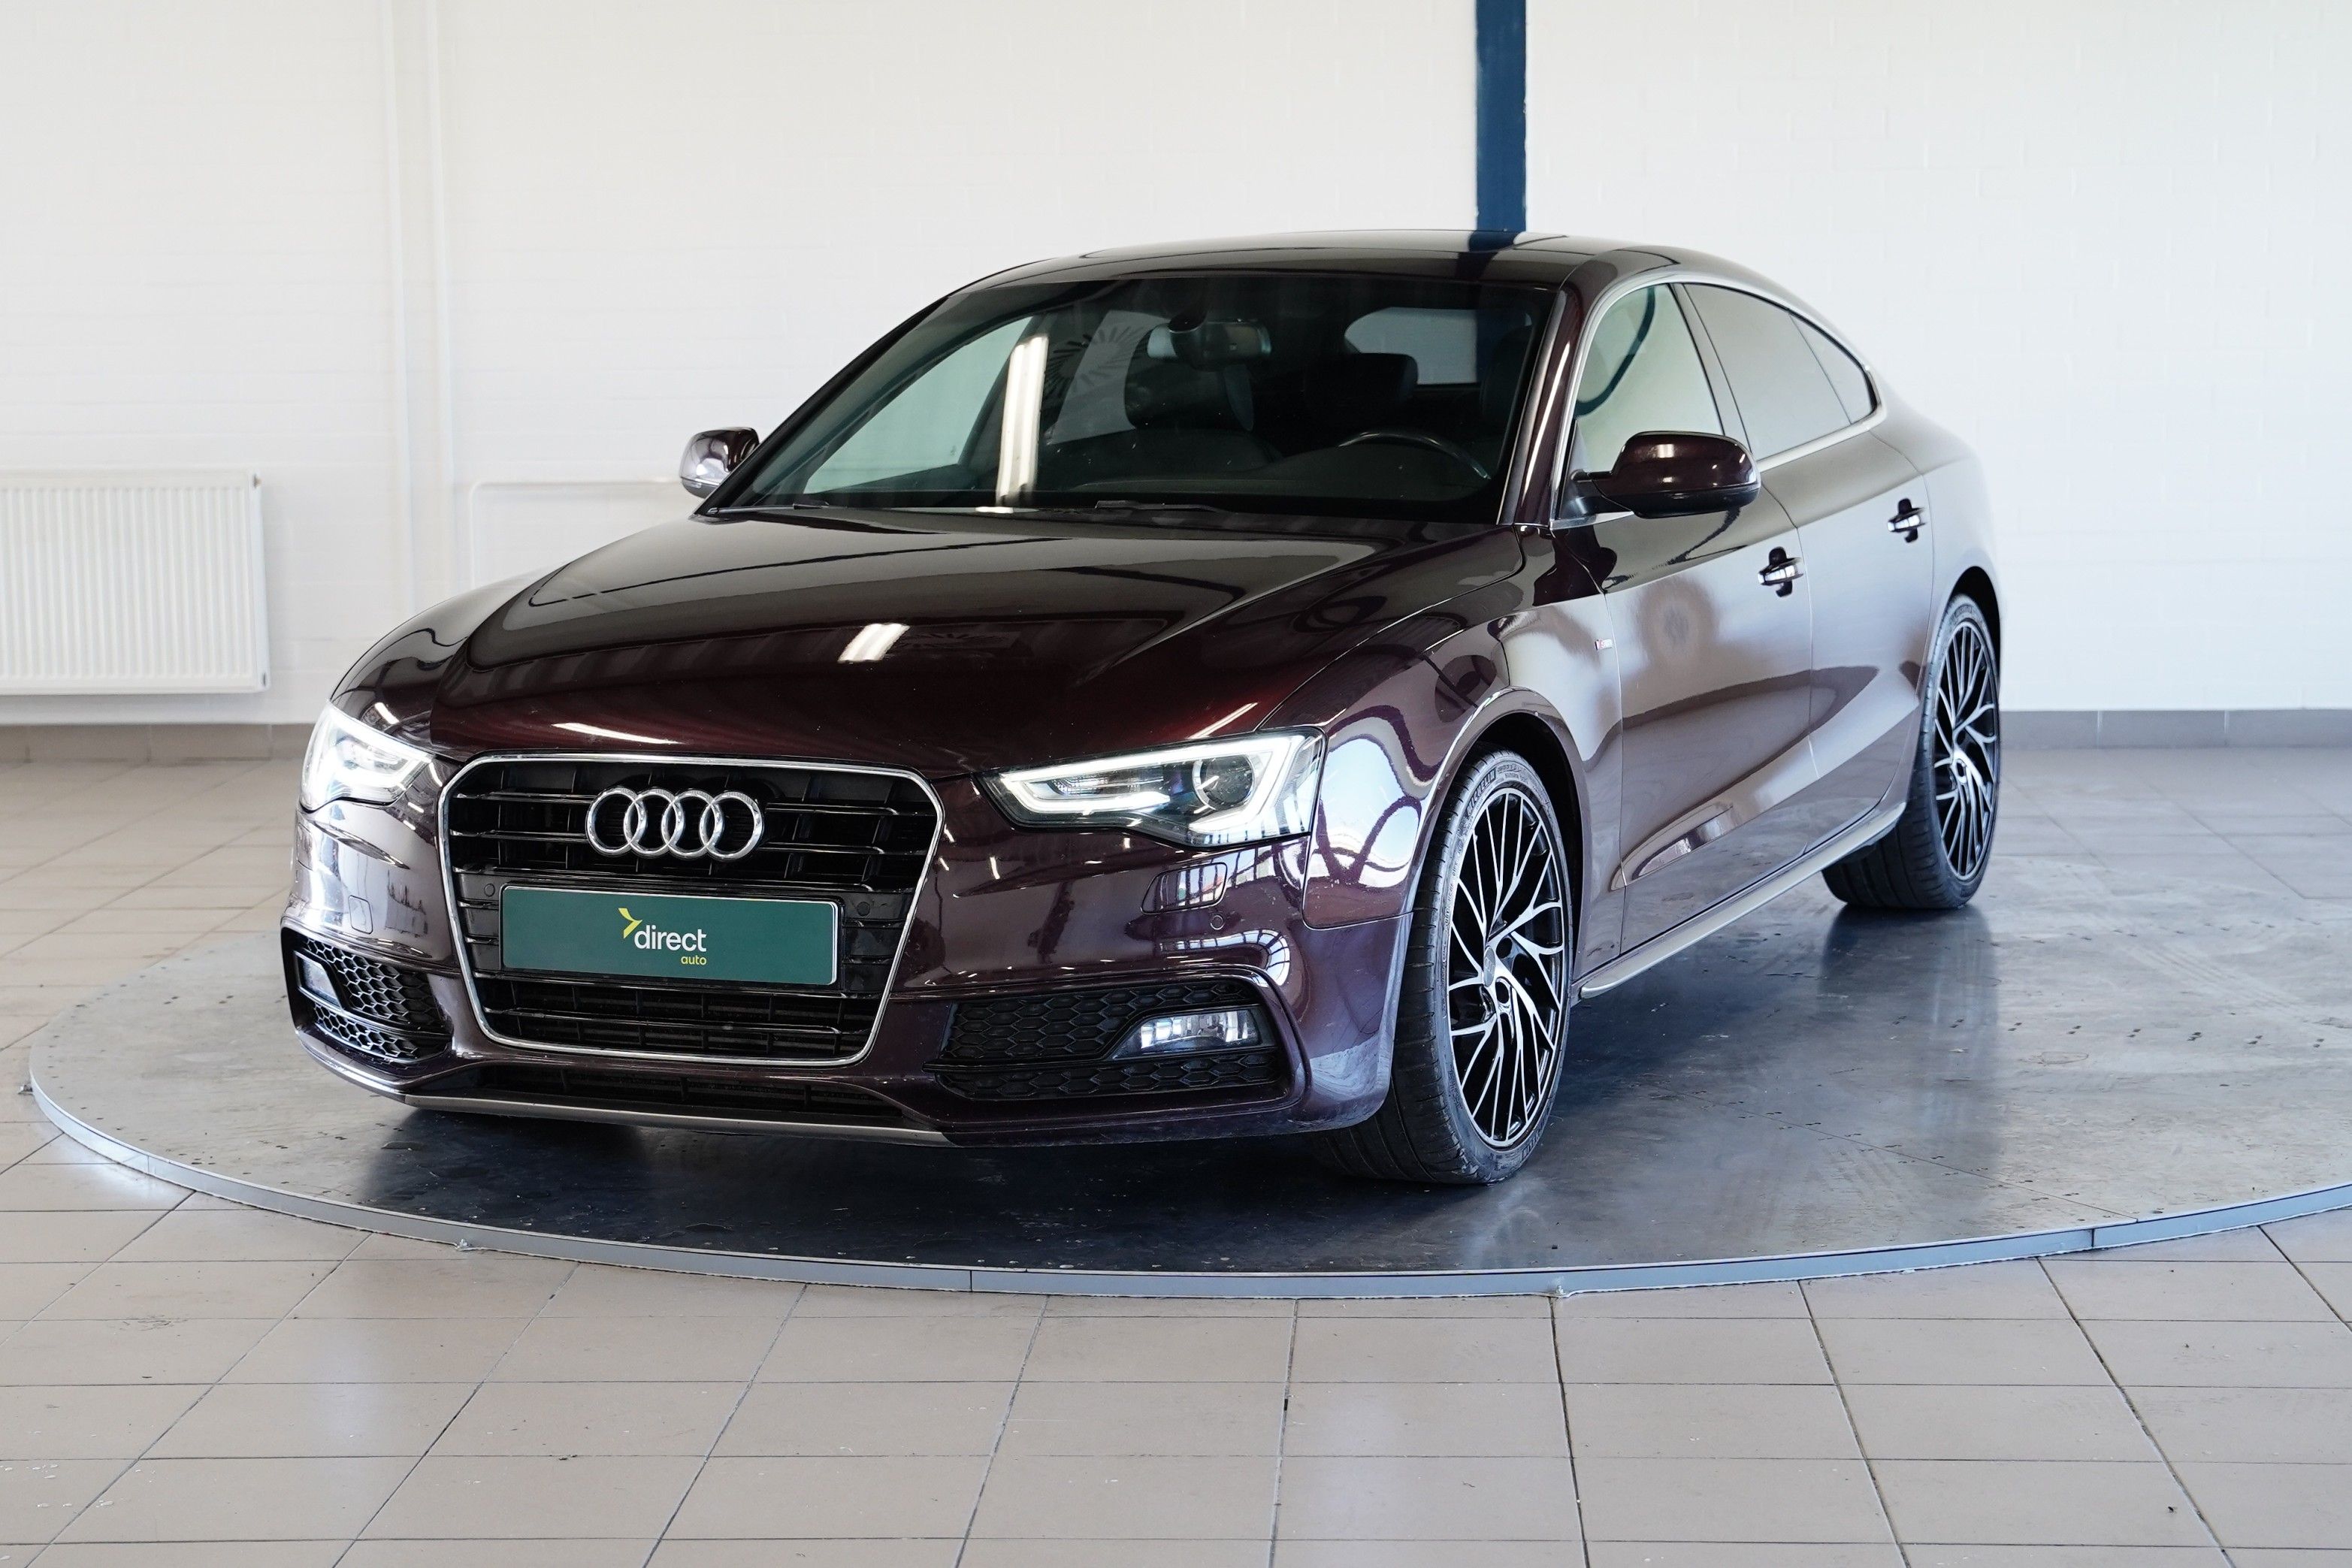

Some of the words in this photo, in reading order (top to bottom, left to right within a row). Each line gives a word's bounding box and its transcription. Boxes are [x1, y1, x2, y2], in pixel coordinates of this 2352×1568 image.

[1468, 768, 1496, 817] MICHELIN
[634, 925, 707, 952] direct
[681, 955, 707, 965] auto
